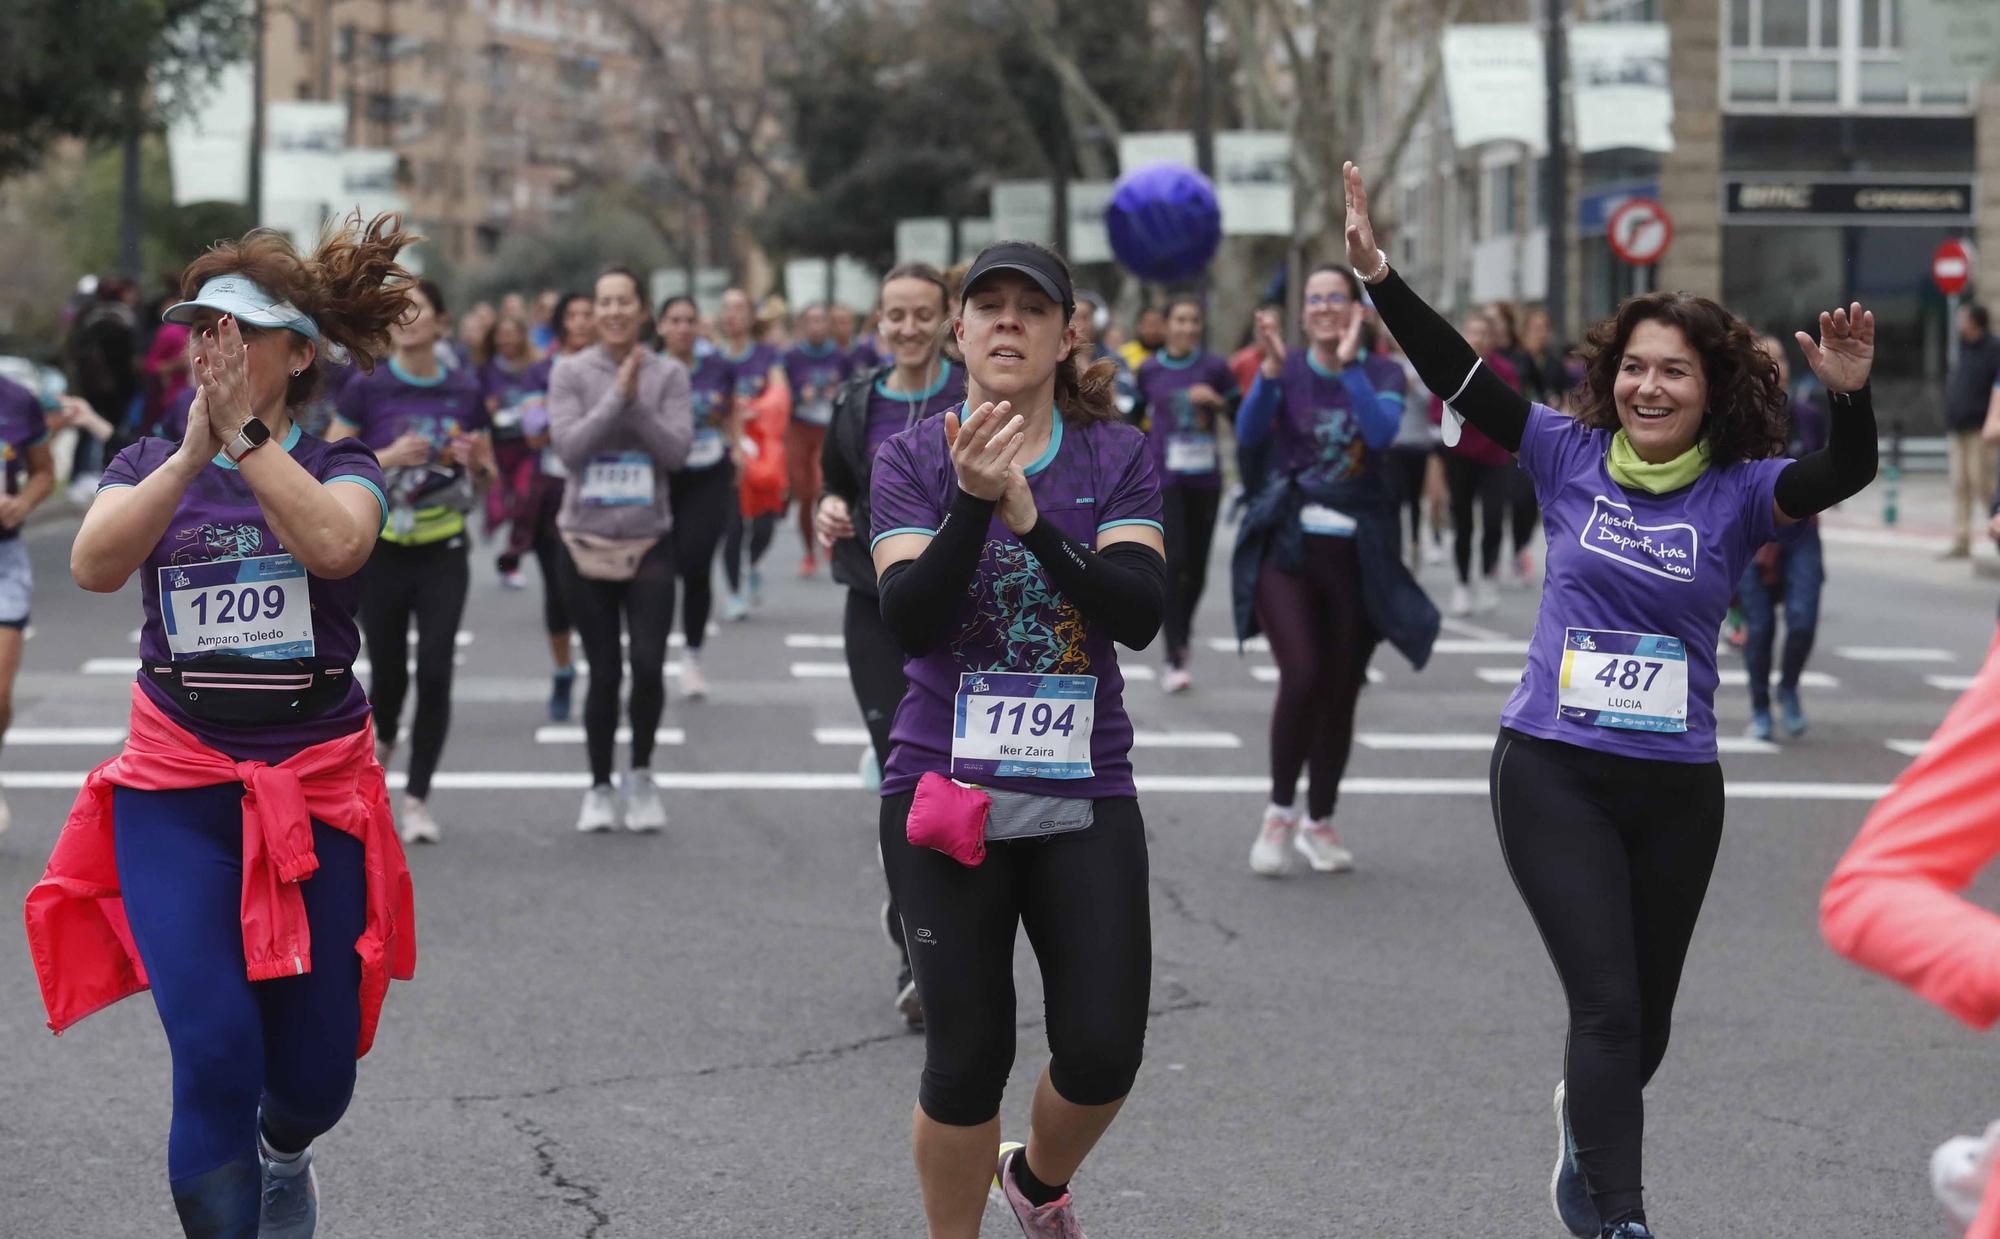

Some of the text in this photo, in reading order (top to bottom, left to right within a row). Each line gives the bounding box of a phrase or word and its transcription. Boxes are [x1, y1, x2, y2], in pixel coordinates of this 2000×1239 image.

[190, 585, 285, 625] 1209
[198, 629, 284, 647] Amparo Toledo
[1594, 658, 1663, 692] 487
[1607, 697, 1642, 710] LUCIA
[986, 700, 1076, 737] 1194
[999, 744, 1055, 757] Iker Zaira
